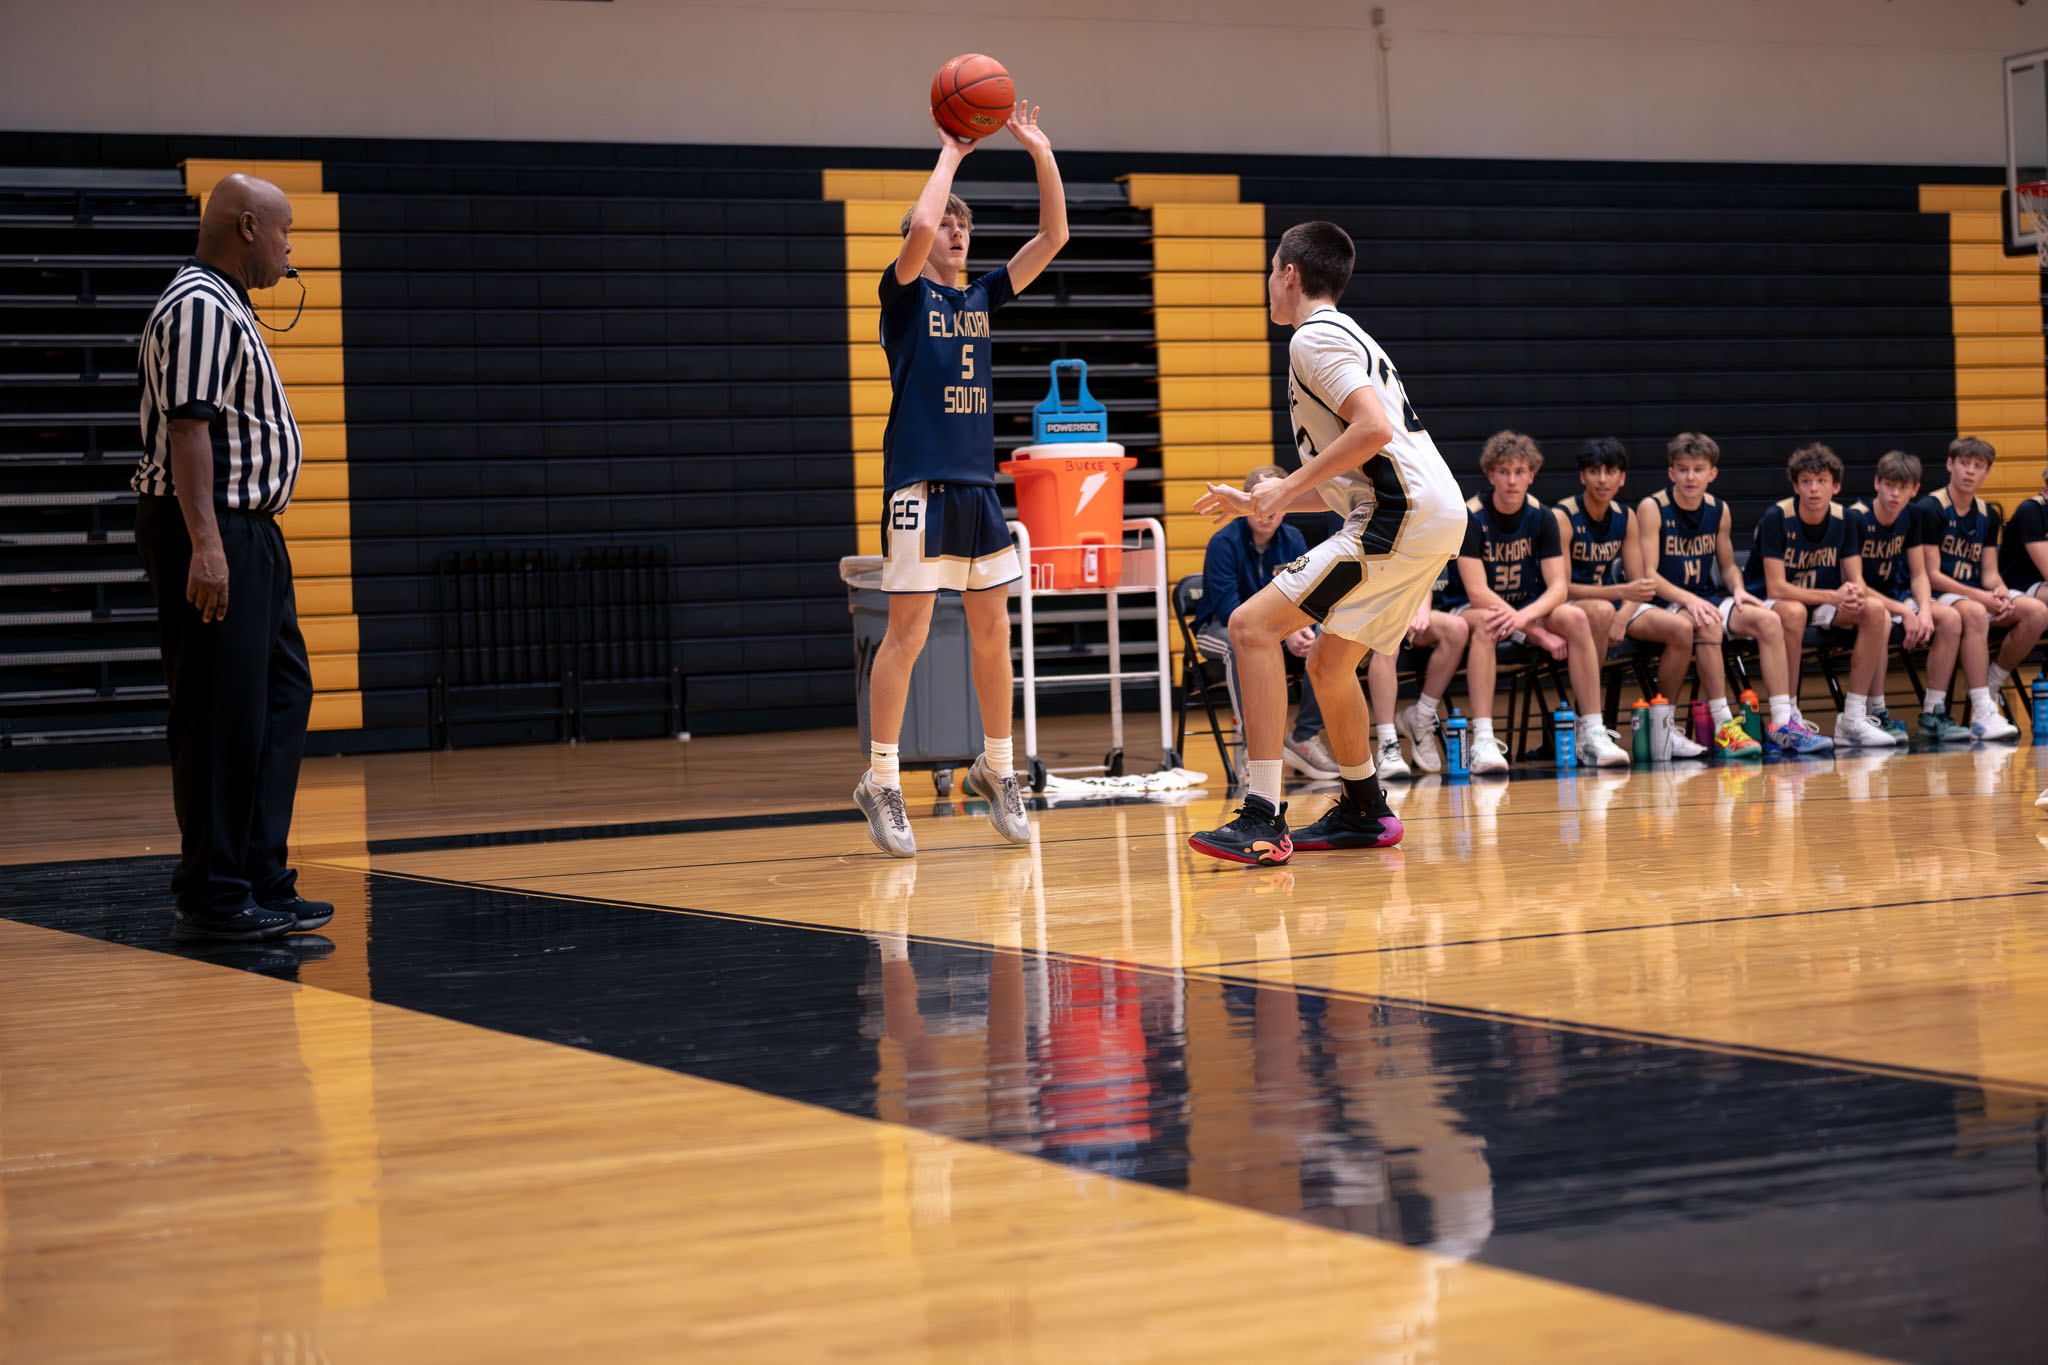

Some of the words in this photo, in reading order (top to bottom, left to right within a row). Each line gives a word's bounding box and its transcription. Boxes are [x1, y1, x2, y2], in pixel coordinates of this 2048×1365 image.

[929, 310, 990, 338] ELKHORN
[962, 344, 974, 379] 5
[944, 386, 987, 414] SOUTH
[1047, 423, 1099, 433] POWERADE
[892, 500, 919, 530] ES
[1494, 564, 1522, 591] 35
[1684, 559, 1701, 585] 14
[1879, 561, 1892, 581] 4
